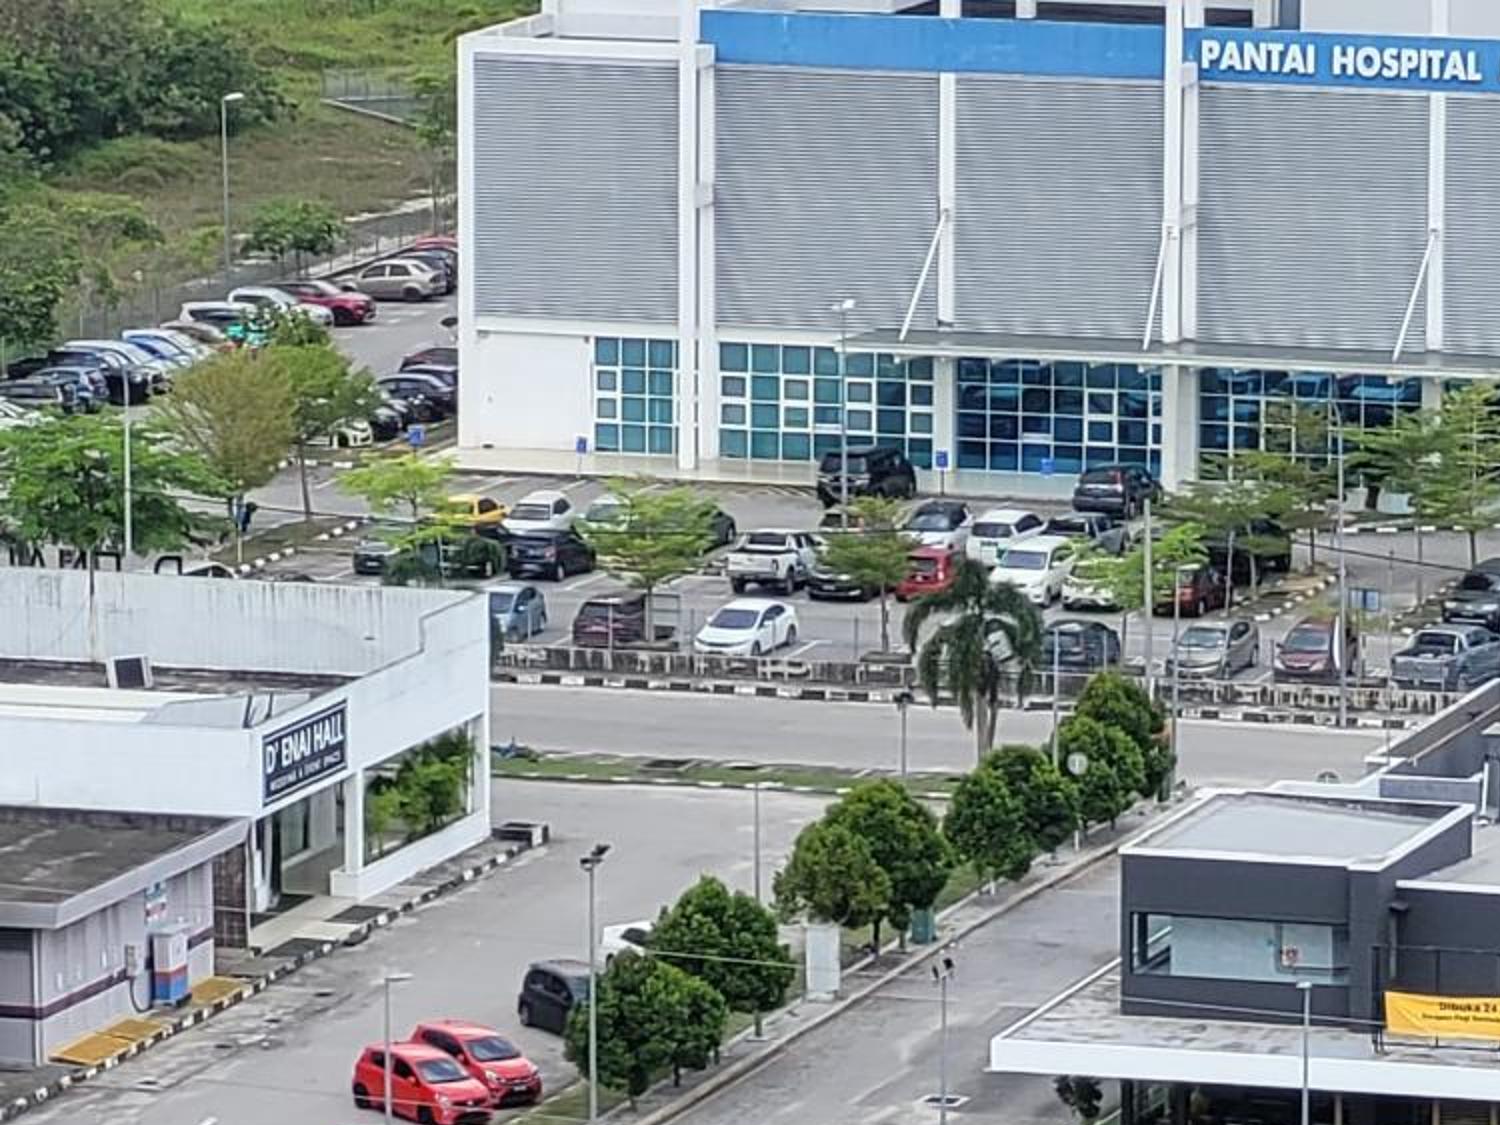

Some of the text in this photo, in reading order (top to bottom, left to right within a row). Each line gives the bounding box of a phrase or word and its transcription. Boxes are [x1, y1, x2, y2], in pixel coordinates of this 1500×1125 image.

[1201, 39, 1316, 75] PANTAI
[1332, 45, 1482, 81] HOSPITAL
[314, 713, 344, 752] HALL
